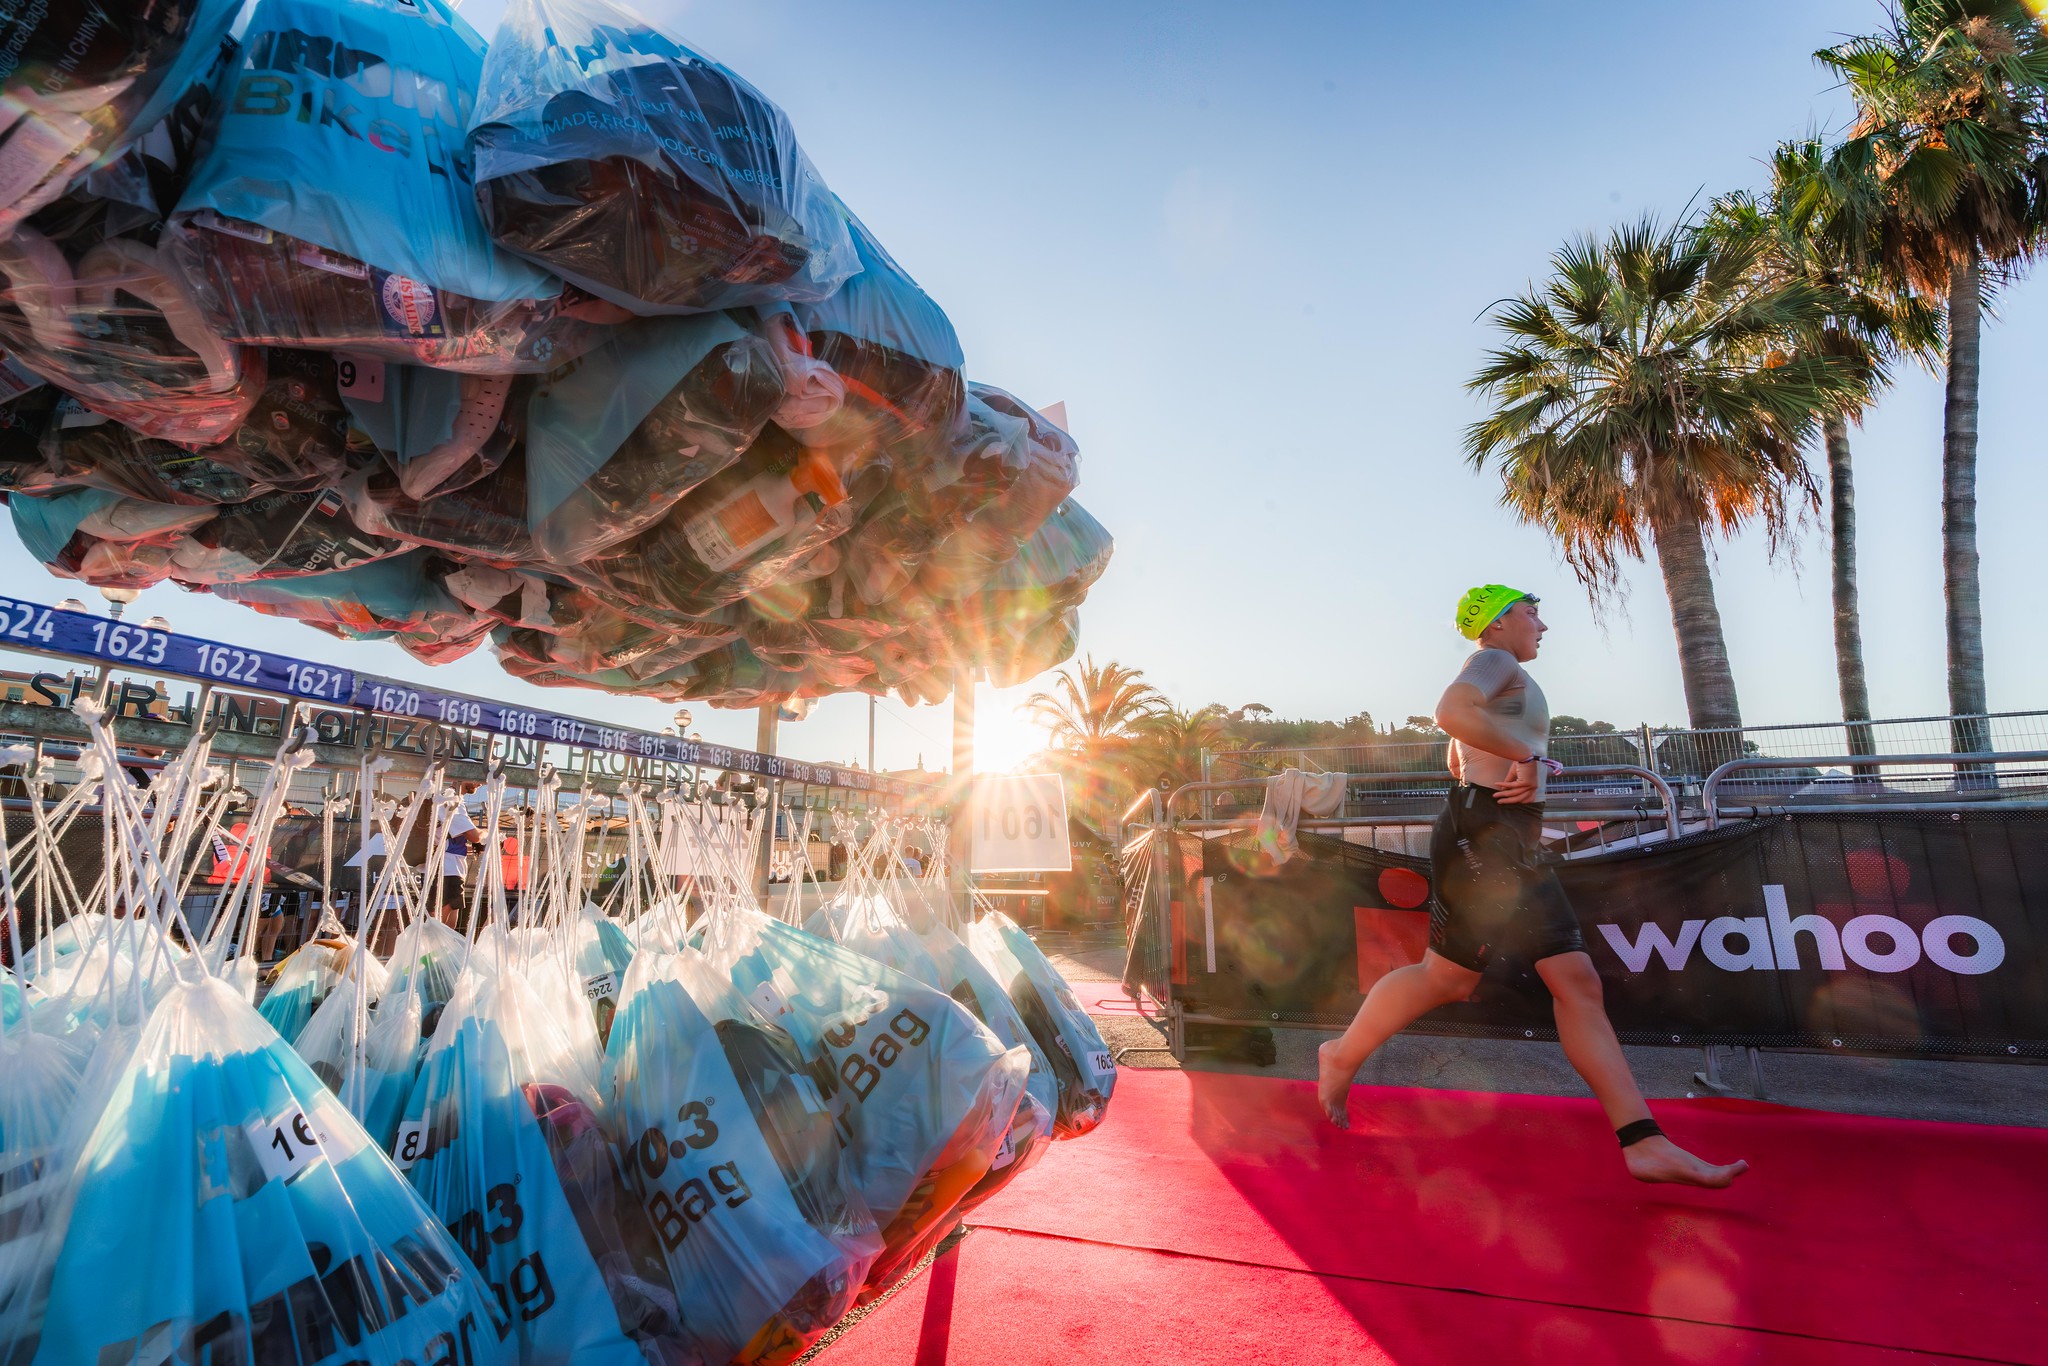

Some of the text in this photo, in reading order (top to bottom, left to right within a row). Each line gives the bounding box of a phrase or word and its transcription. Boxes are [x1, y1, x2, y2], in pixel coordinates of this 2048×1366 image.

[58, 53, 80, 73] IN
[544, 110, 597, 136] MADE
[695, 213, 710, 225] For
[711, 220, 727, 232] this
[265, 387, 329, 426] ATERIAL
[92, 621, 169, 665] 1623
[197, 644, 262, 684] 1622
[286, 663, 343, 699] 1621
[30, 673, 158, 718] SUR
[182, 691, 258, 733] UN
[372, 686, 420, 717] 1620
[438, 698, 481, 727] 1619
[498, 709, 537, 736] 1618
[551, 718, 586, 744] 1617
[597, 727, 628, 751] 1616
[638, 735, 667, 758] 1615
[676, 742, 700, 763] 1614
[709, 747, 732, 769] 1613
[739, 752, 760, 772] 1612
[766, 757, 787, 777] 1611
[792, 763, 810, 781] 1610
[815, 767, 832, 785] 1609
[837, 771, 852, 787] 1608
[856, 774, 871, 790] 1607
[1596, 884, 2006, 975] wahoo
[587, 982, 613, 1000] 2249
[840, 1007, 931, 1104] Bag
[648, 1160, 753, 1254] Bag
